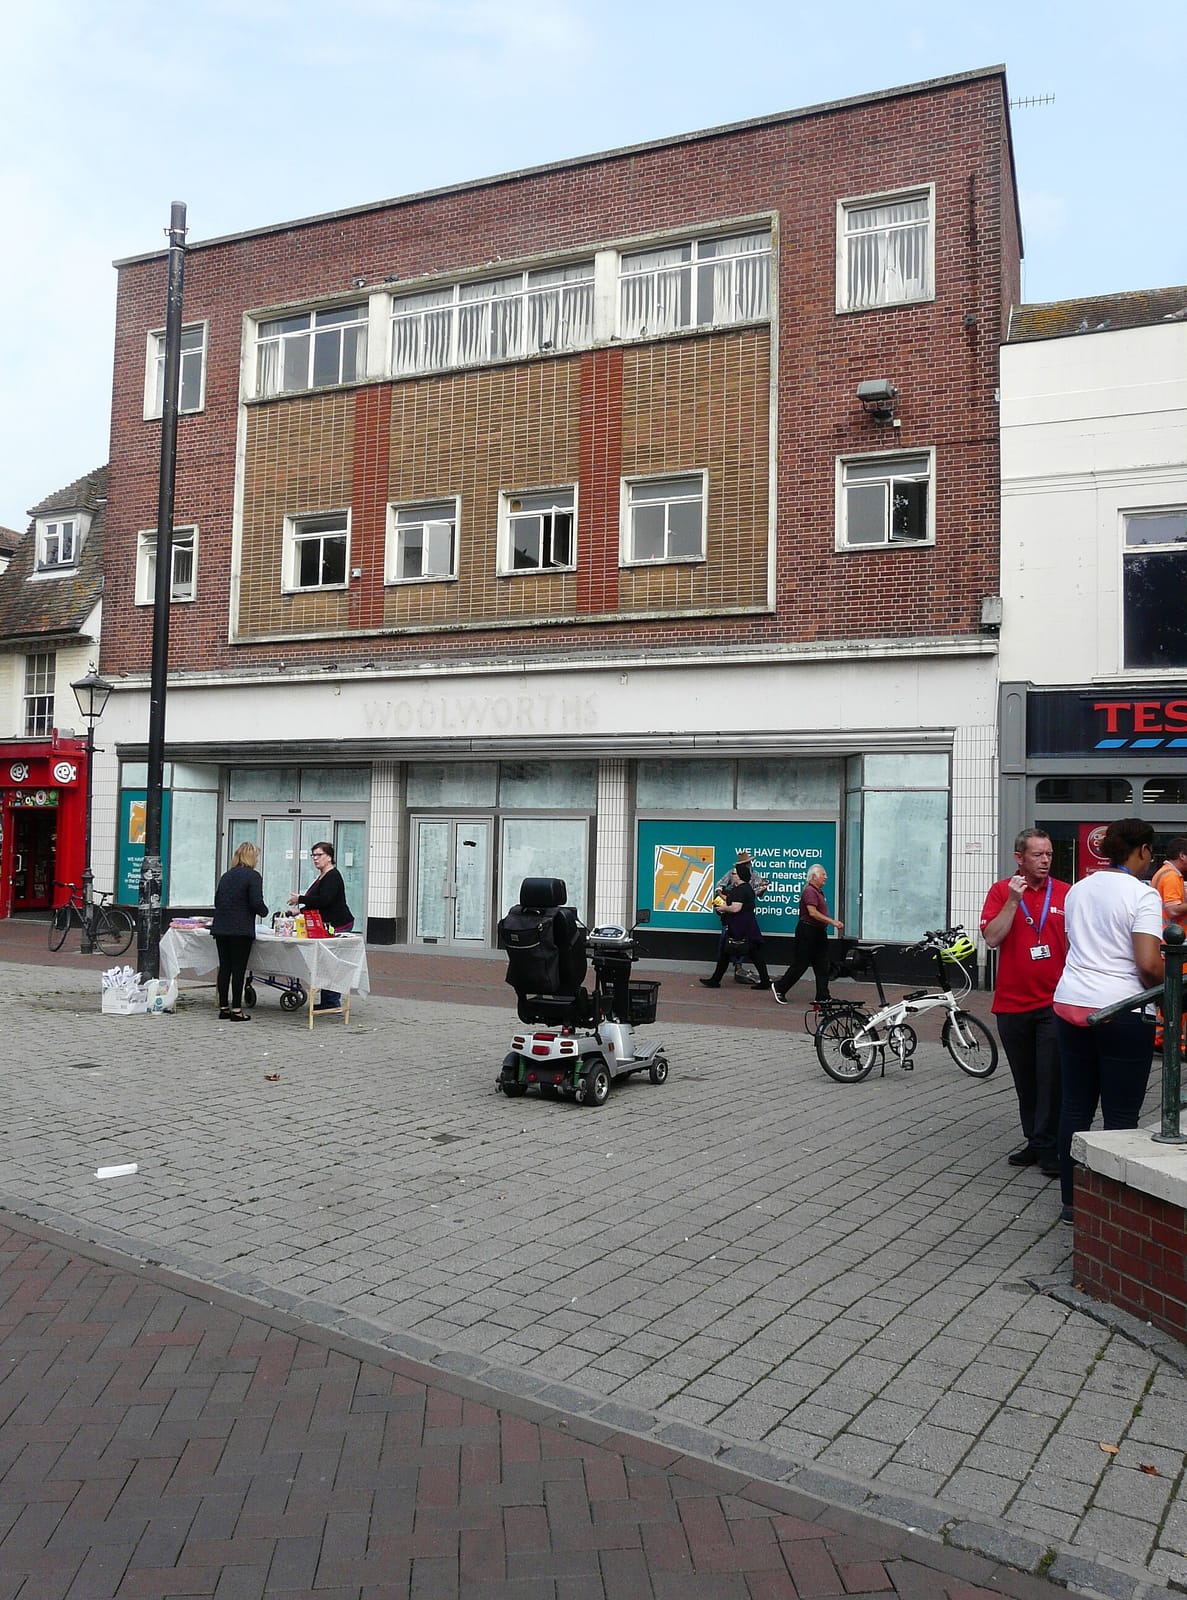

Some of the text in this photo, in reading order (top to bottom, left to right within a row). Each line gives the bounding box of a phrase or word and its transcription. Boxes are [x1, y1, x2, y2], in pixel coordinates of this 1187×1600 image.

[363, 693, 598, 731] WOOLWORTHS
[735, 848, 823, 858] WE HAVE MOVED!
[750, 860, 767, 868] You
[788, 860, 807, 868] find
[772, 871, 807, 879] nearest
[767, 881, 801, 893] dland
[754, 905, 782, 916] pping
